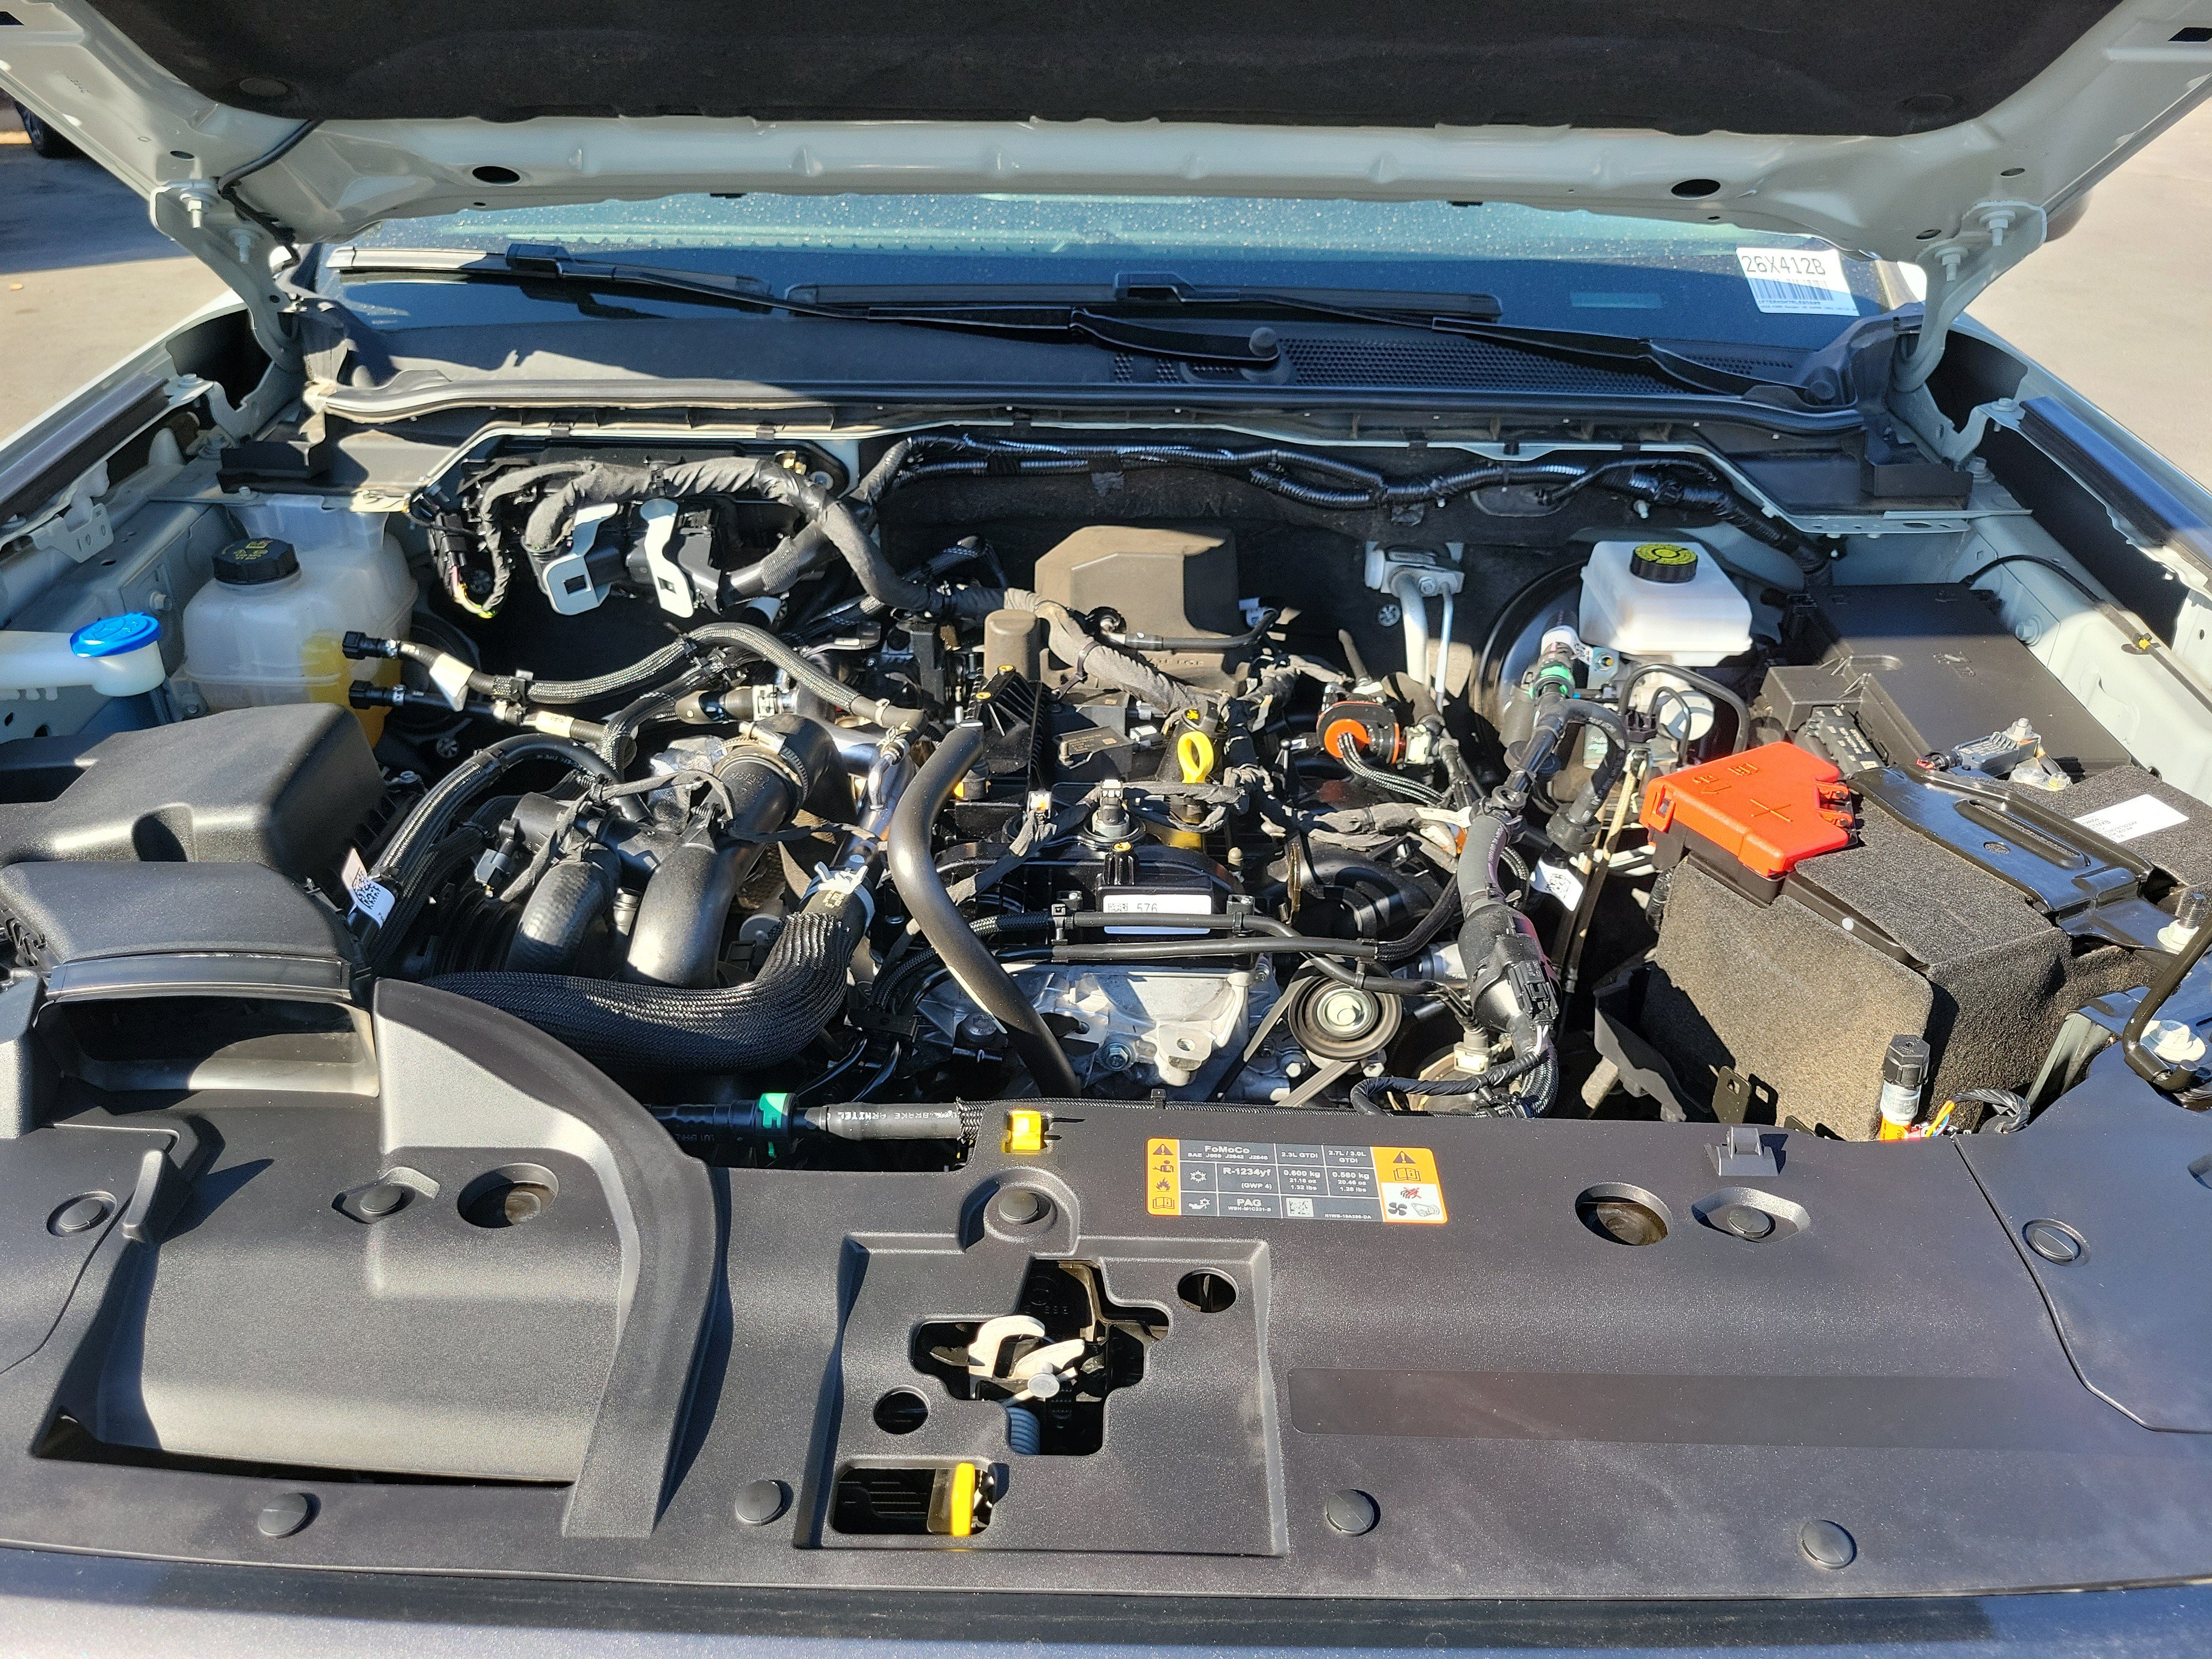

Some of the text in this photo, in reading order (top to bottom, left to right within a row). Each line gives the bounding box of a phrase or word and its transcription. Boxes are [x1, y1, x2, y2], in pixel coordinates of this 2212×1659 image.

[1741, 256, 1826, 275] 26X412B
[1137, 903, 1158, 913] 576
[1205, 1145, 1250, 1154] FoMoCo
[1223, 1167, 1271, 1177] R-1234yf
[1310, 1170, 1321, 1178] kg
[1237, 1198, 1262, 1206] PAG
